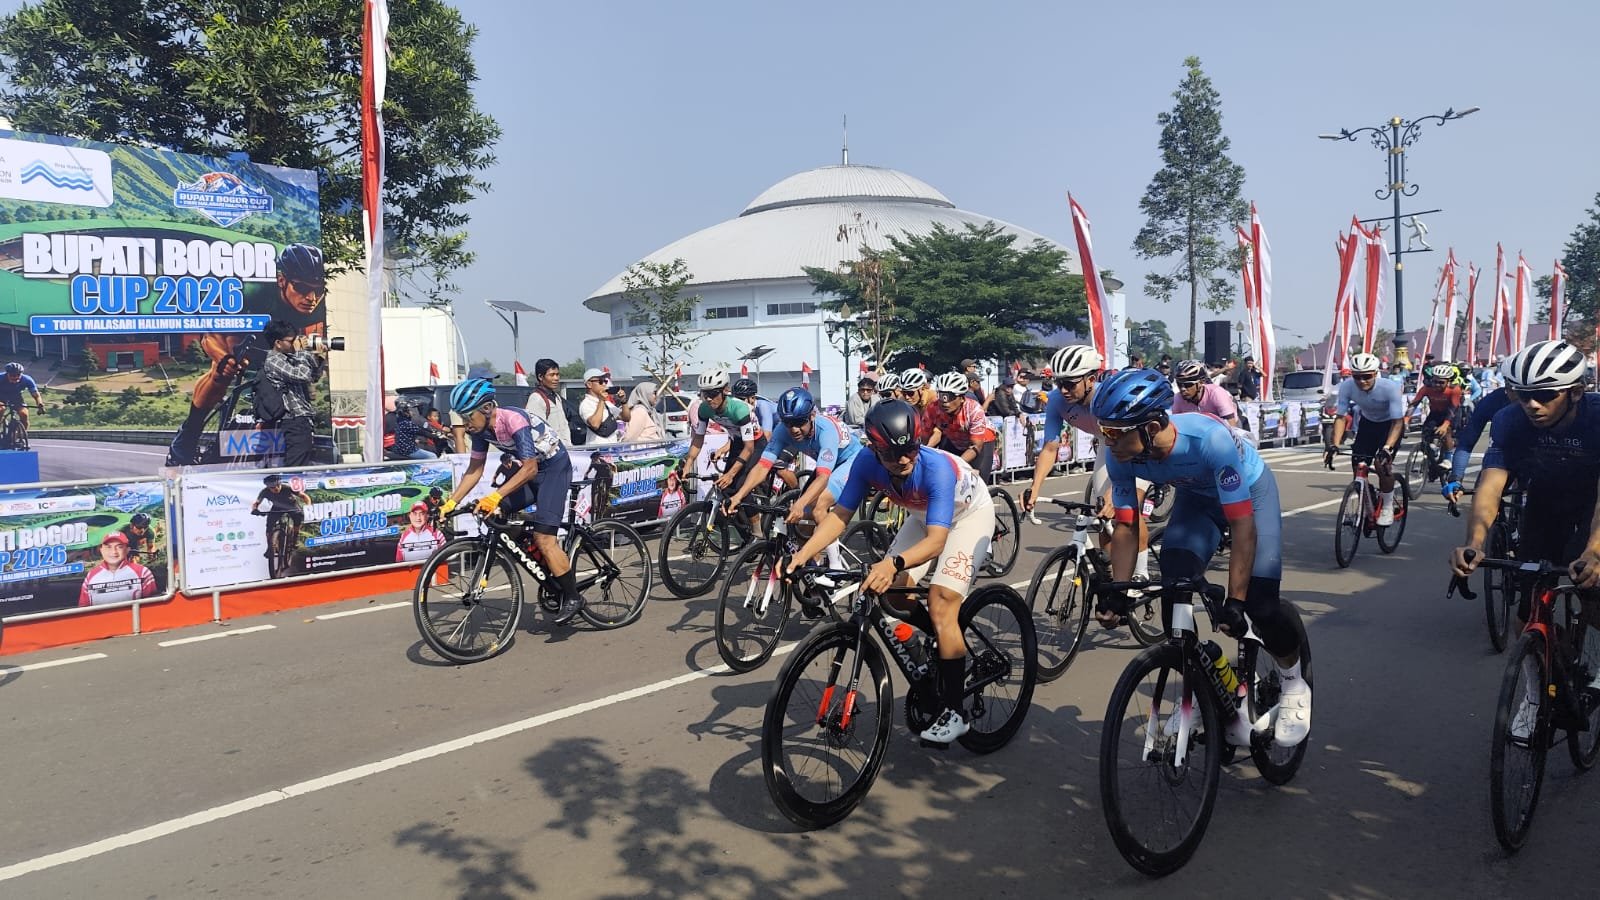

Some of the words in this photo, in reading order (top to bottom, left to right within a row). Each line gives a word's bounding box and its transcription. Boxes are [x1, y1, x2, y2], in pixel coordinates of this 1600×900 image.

[180, 193, 214, 202] BUPATI
[216, 196, 248, 205] BOGOR
[249, 198, 268, 206] CUP
[22, 233, 157, 276] BUPATI
[162, 239, 277, 278] BOGOR
[71, 275, 149, 314] CUP
[153, 276, 244, 315] 2026
[52, 319, 82, 331] TOUR
[84, 318, 137, 330] MALASARI
[138, 318, 182, 330] HALIMUN
[183, 318, 212, 329] SALAK
[214, 318, 244, 329] SERIES
[244, 318, 253, 328] 2
[303, 500, 353, 521] BUPATI
[355, 493, 402, 514] BOGOR
[19, 522, 88, 548] BOGOR
[320, 516, 350, 537] CUP
[351, 511, 388, 532] 2026
[13, 544, 67, 571] 2026
[879, 617, 922, 681] COLNAGO
